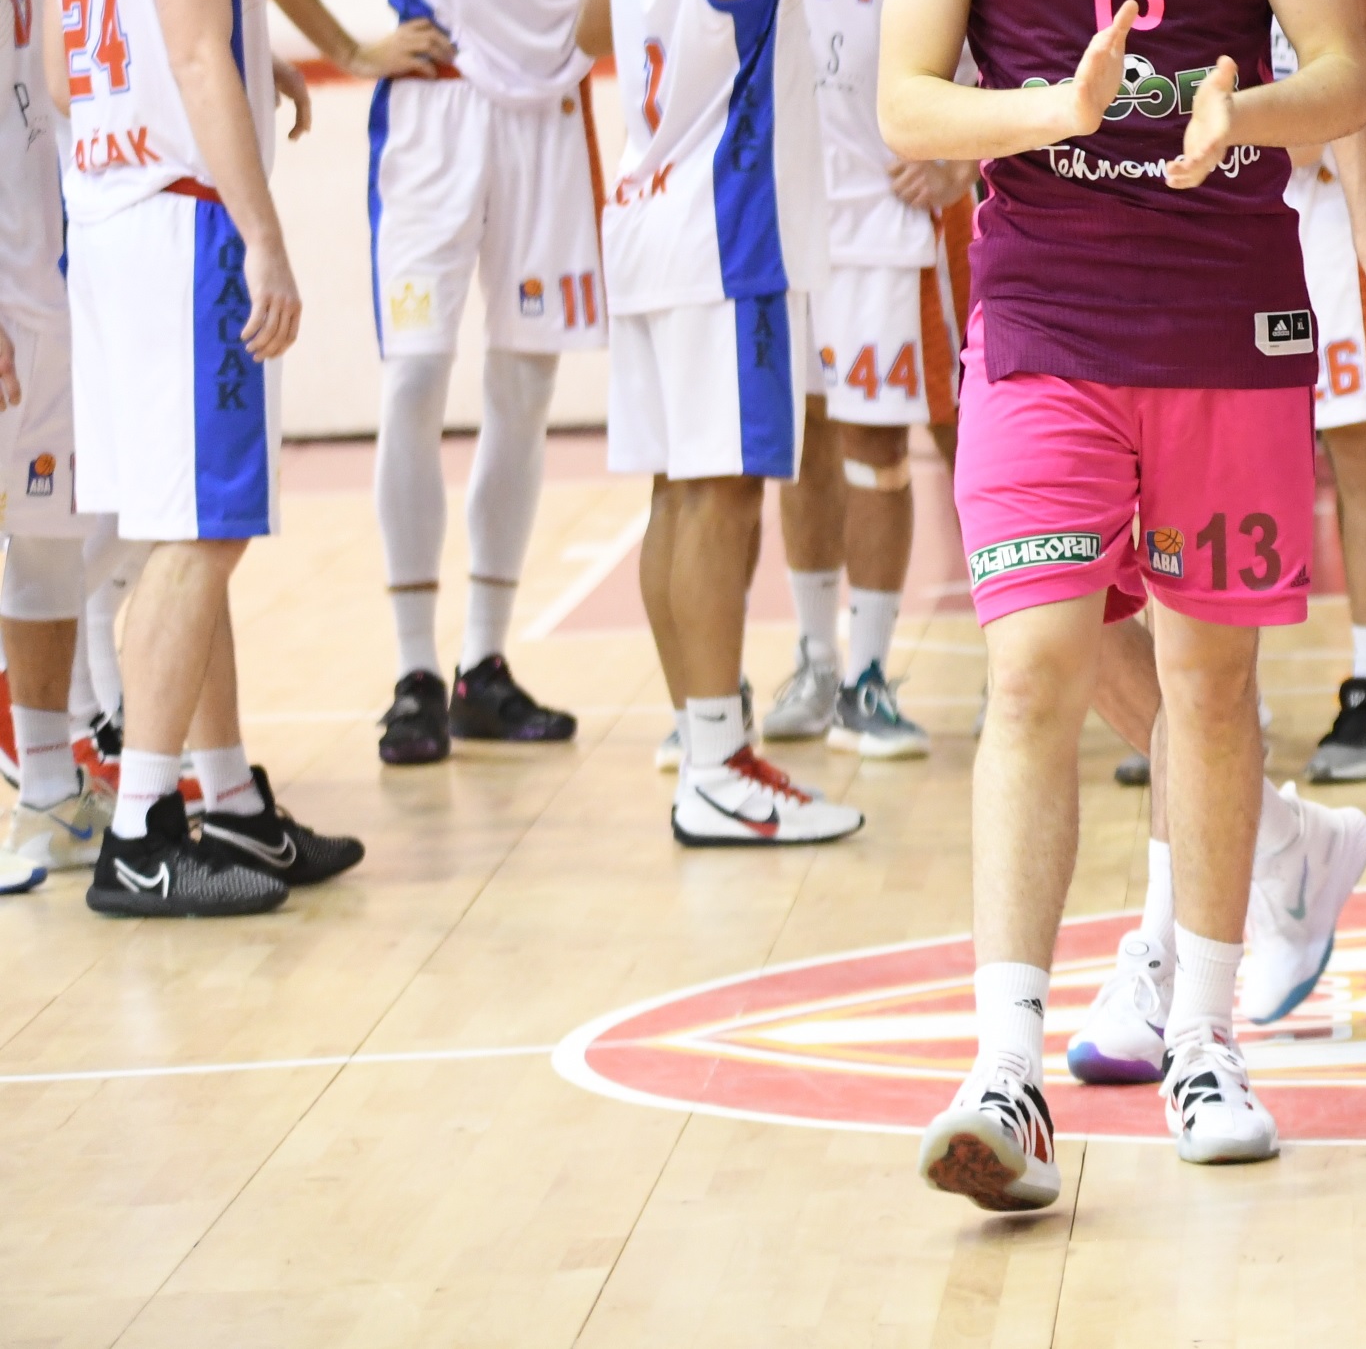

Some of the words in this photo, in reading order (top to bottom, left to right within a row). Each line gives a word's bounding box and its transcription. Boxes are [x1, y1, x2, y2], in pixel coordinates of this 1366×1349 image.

[74, 126, 162, 173] AČAK
[558, 271, 600, 330] 11
[844, 341, 921, 401] 44
[1152, 552, 1180, 575] ABA
[1195, 512, 1283, 592] 13
